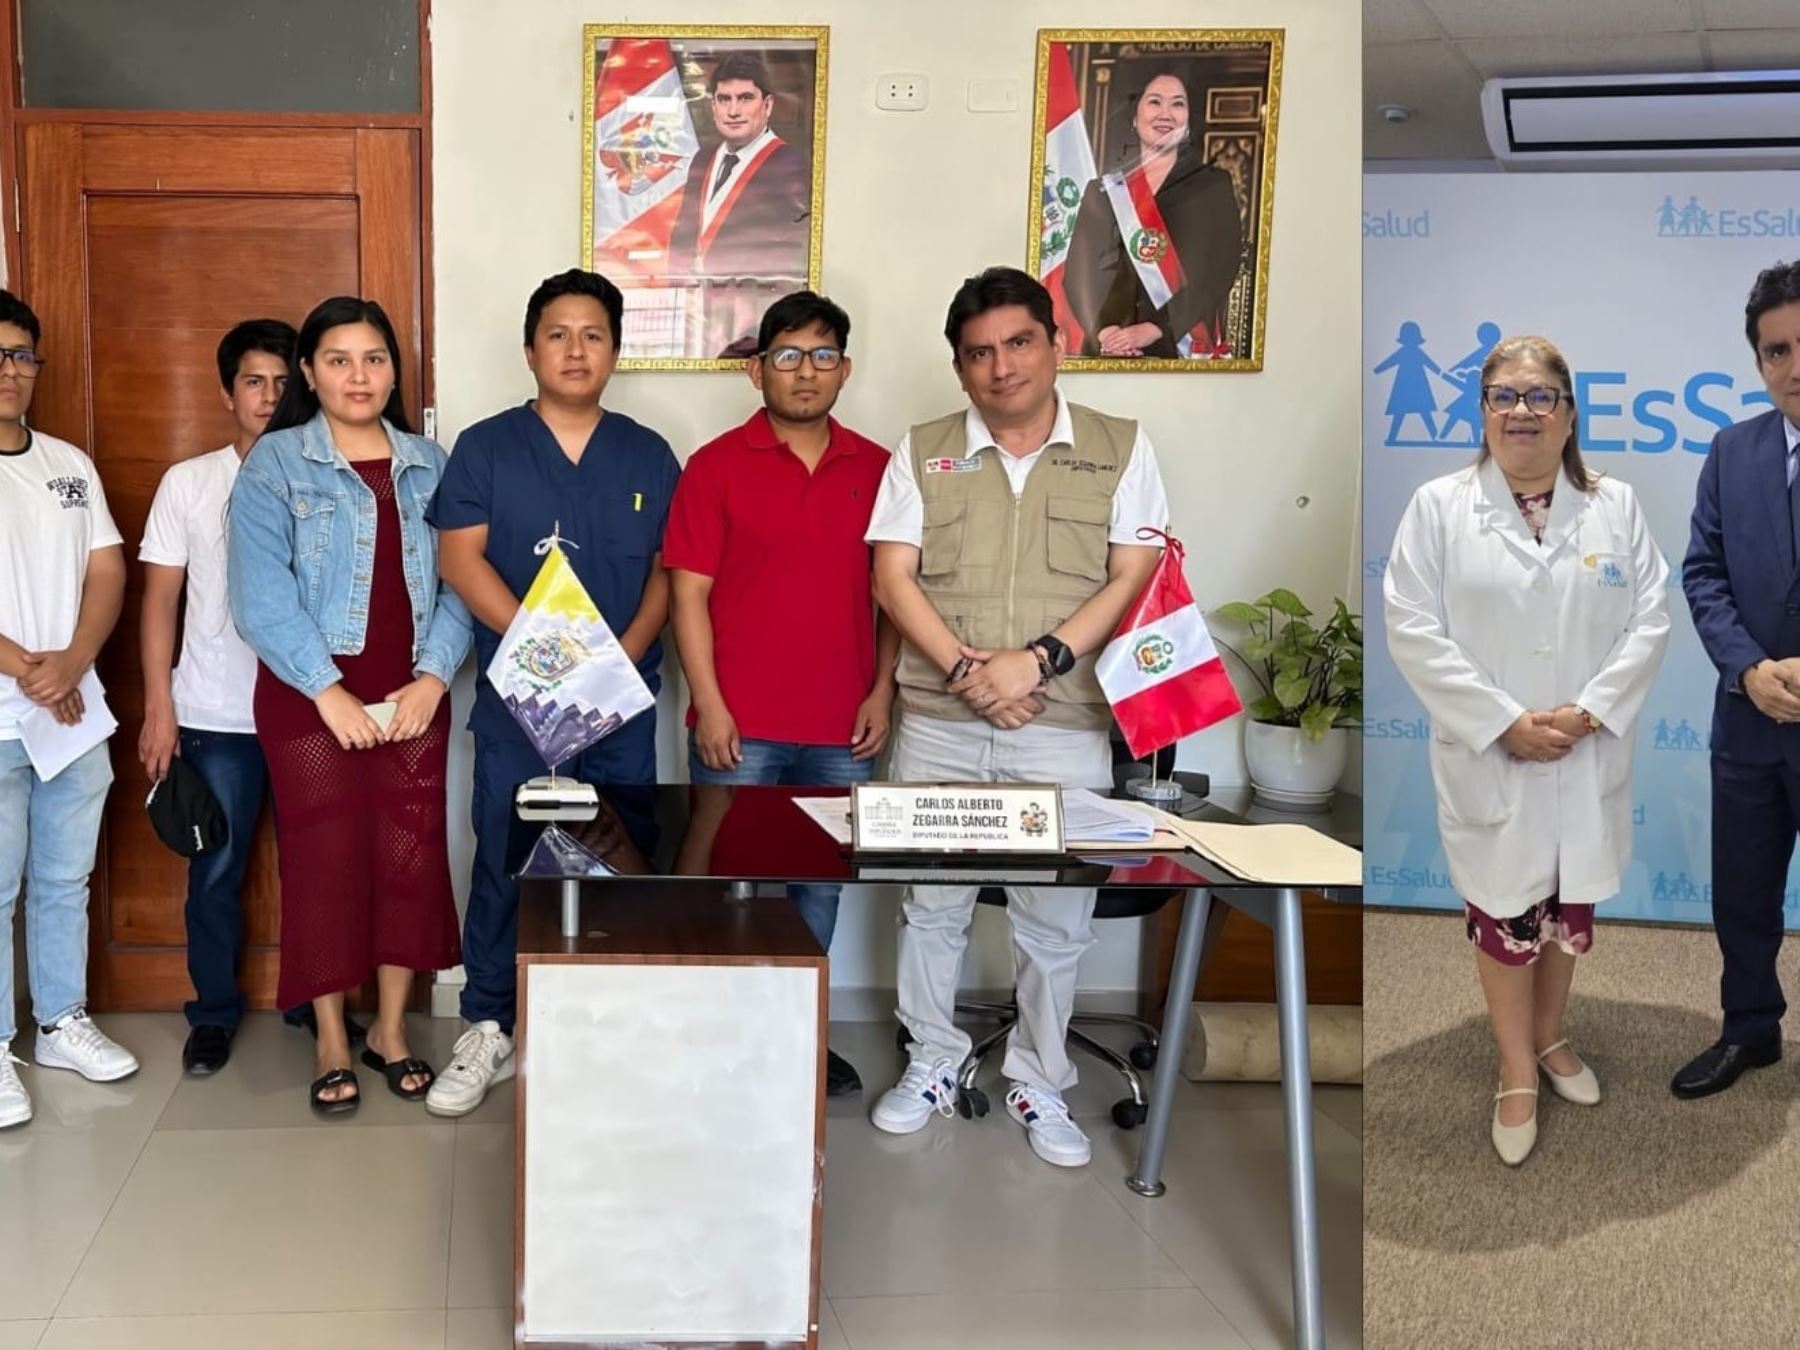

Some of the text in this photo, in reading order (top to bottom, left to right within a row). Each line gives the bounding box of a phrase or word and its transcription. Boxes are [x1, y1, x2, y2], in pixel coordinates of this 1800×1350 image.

[1575, 372, 1776, 454] EsS
[915, 797, 1003, 811] CARLOS ALBERTO
[912, 814, 959, 827] ZEGARRA
[961, 812, 1008, 828] SÁNCHEZ
